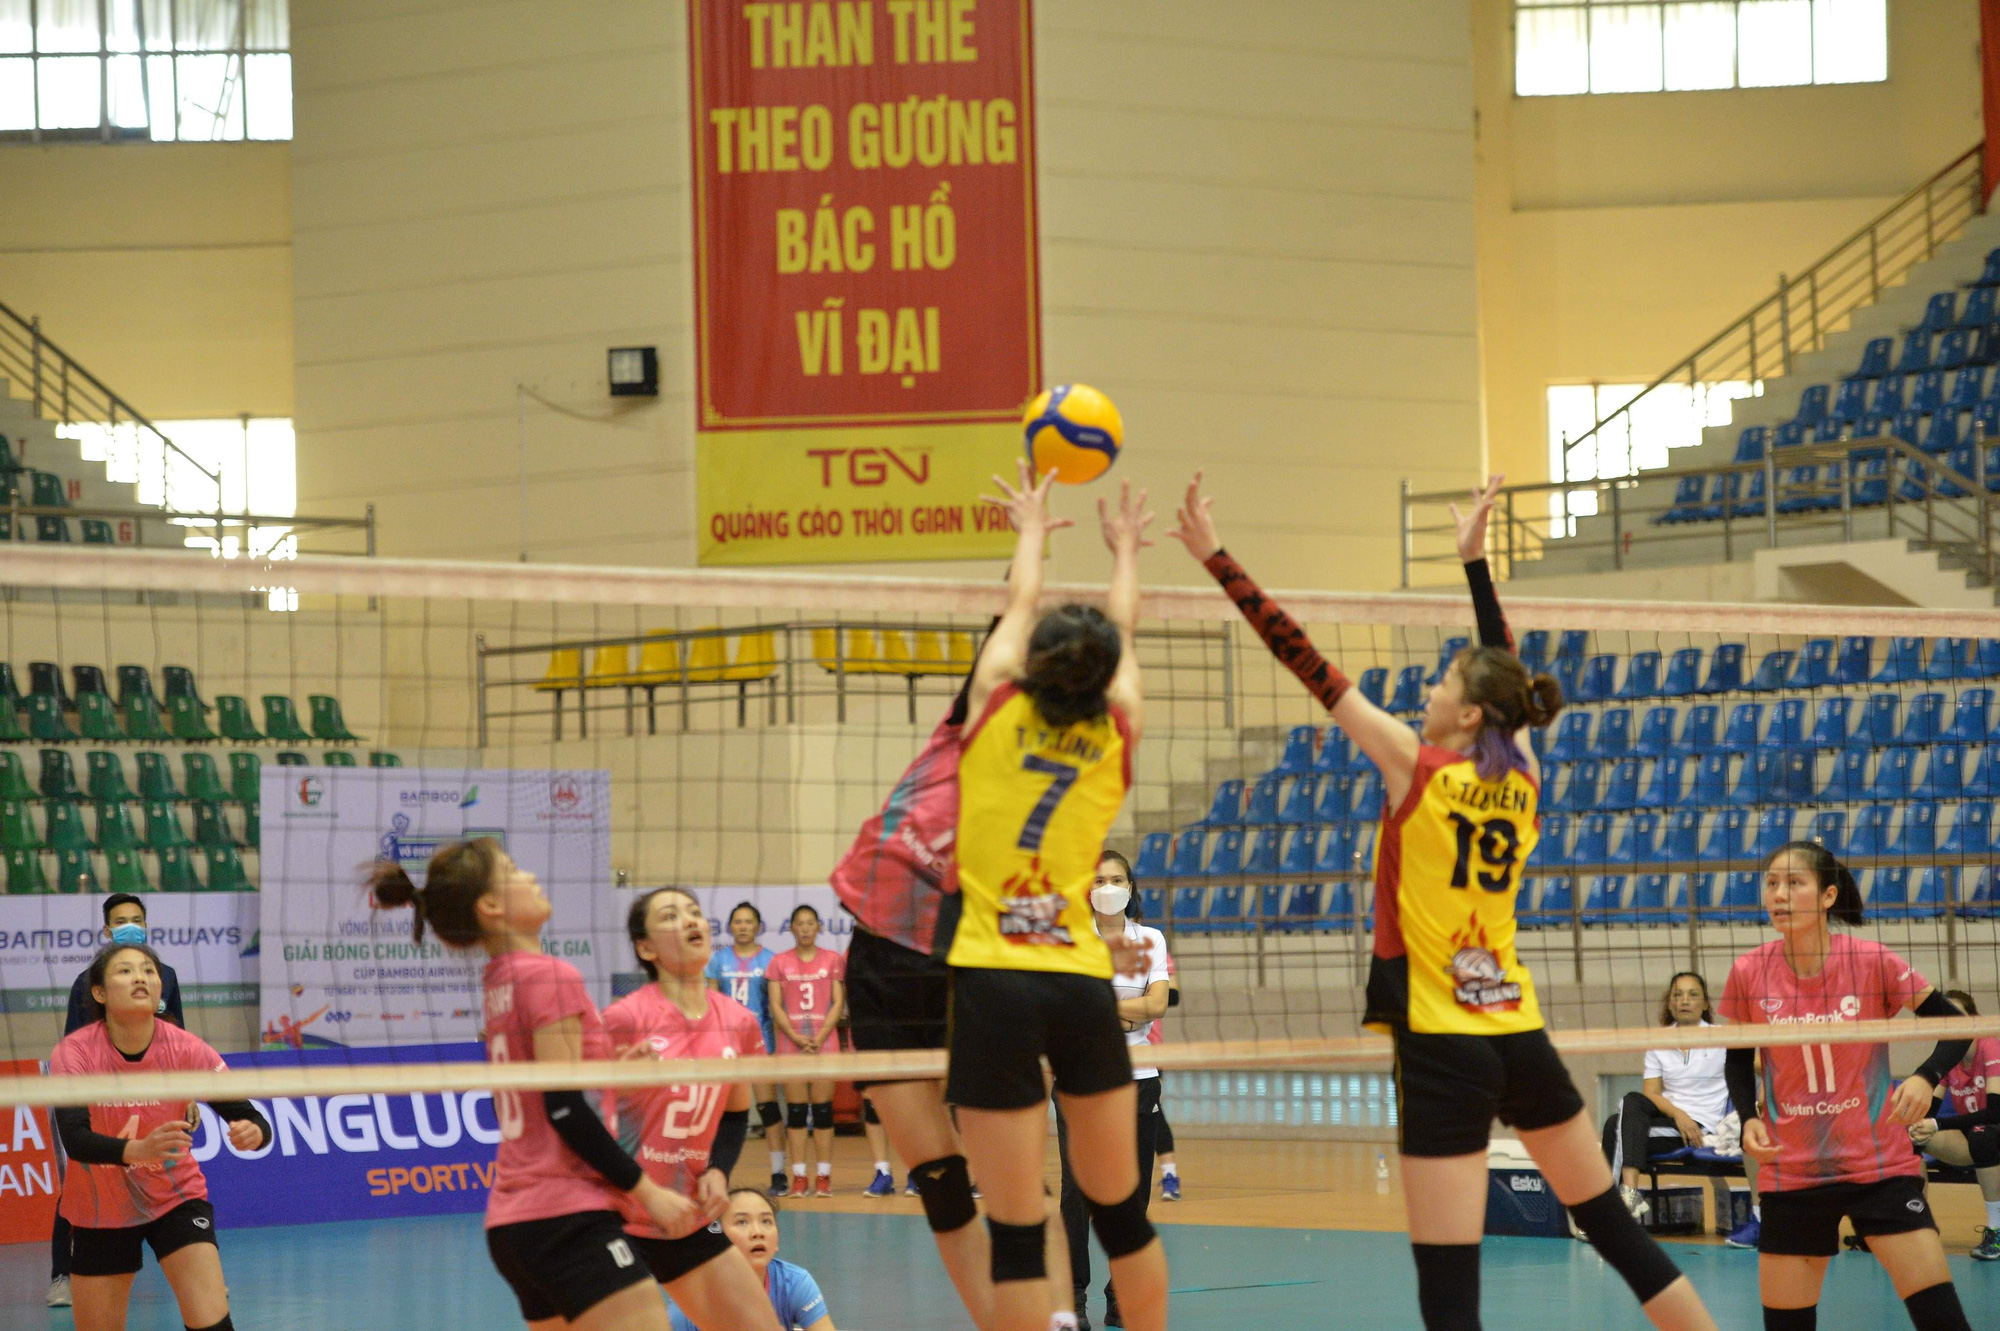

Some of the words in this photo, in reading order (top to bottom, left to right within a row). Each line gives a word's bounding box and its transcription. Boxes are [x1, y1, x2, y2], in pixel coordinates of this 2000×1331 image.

[710, 105, 834, 174] THEO
[850, 94, 1017, 170] GƯƠNG
[776, 193, 875, 274] BÁC
[795, 297, 845, 376] VĨ
[857, 306, 941, 388] ĐẠI
[911, 506, 963, 534] GIAN
[1017, 753, 1079, 850] 7
[1448, 811, 1519, 893] 19
[730, 978, 750, 1008] 14
[799, 982, 815, 1011] 3
[1801, 1043, 1836, 1094] 11
[662, 1083, 722, 1139] 20
[366, 1160, 500, 1197] SPORT.V
